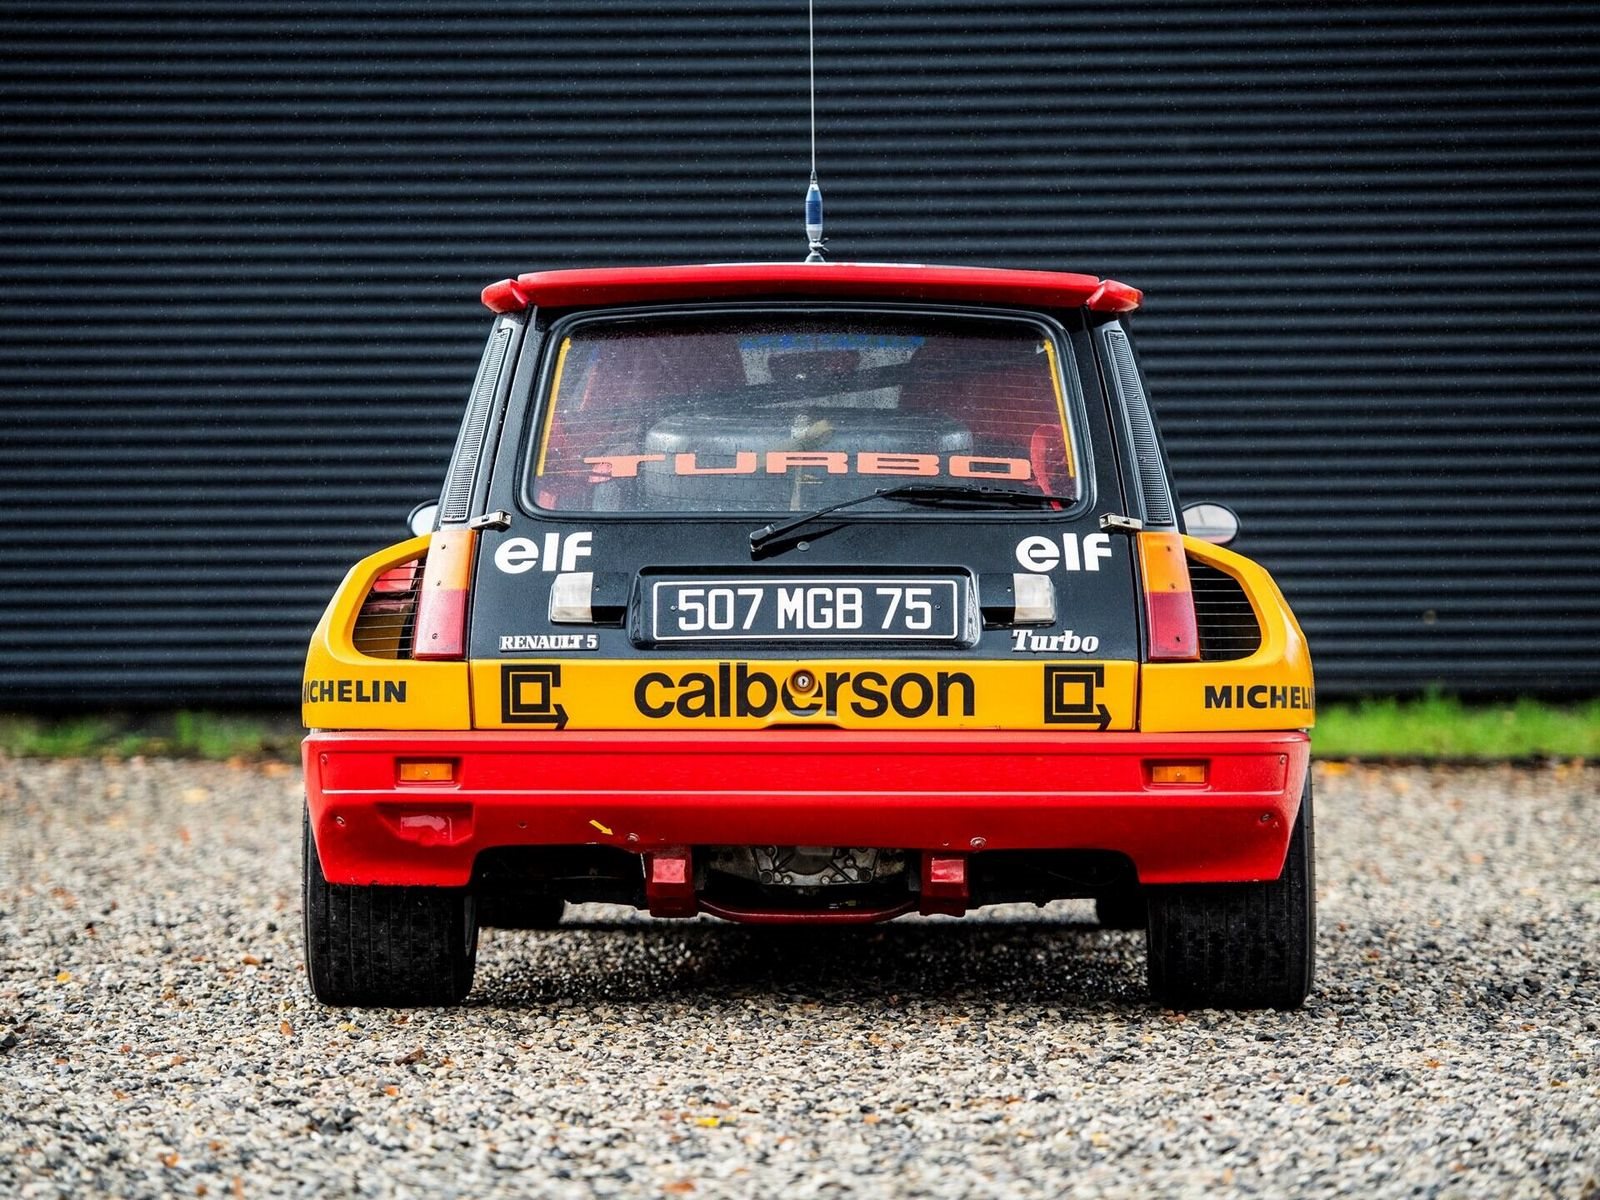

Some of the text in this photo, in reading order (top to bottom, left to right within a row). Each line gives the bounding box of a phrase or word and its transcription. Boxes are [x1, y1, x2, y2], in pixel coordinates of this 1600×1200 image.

[584, 452, 1031, 480] TURBO
[494, 531, 592, 574] elf
[1015, 532, 1112, 572] elf
[678, 588, 932, 630] 507 MGB 75
[501, 634, 597, 650] RENAULT 5
[1011, 629, 1099, 653] Turbo
[634, 662, 975, 718] calberson
